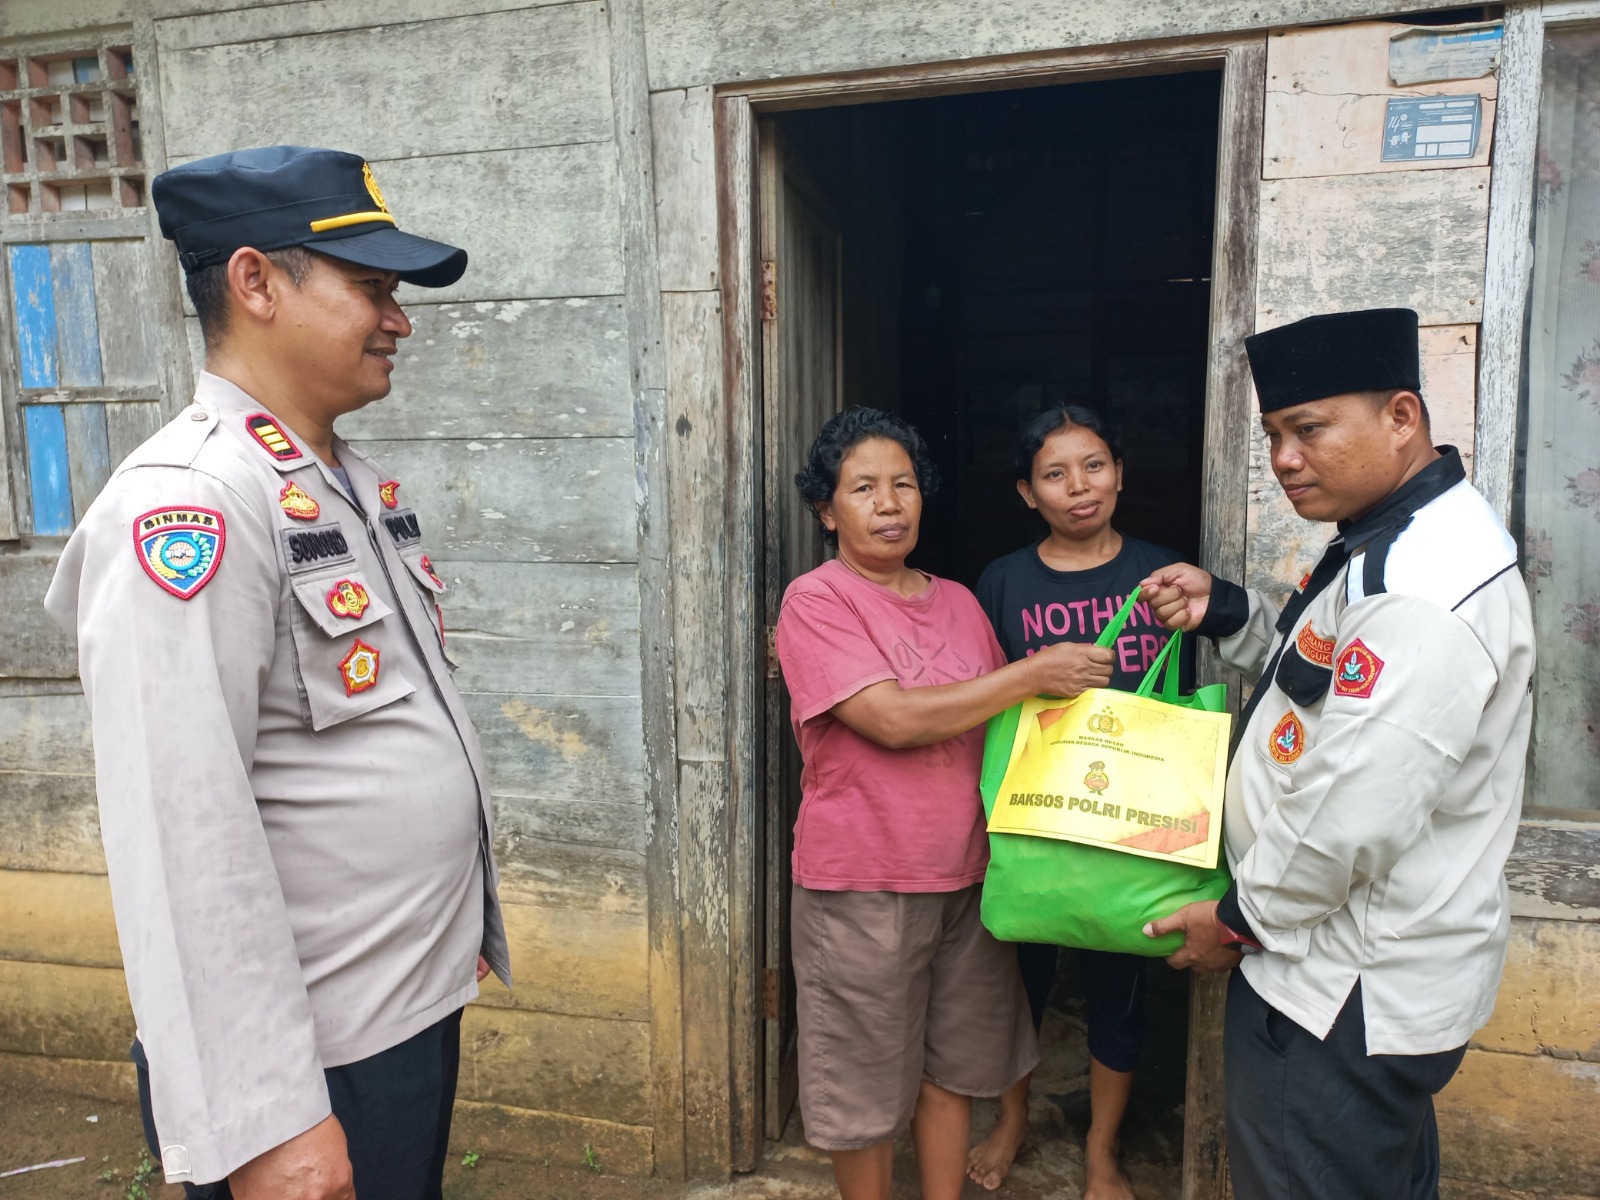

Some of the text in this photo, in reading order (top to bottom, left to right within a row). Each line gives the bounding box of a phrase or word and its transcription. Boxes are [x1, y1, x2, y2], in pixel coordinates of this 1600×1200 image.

[143, 513, 213, 530] BINMAS
[1021, 593, 1165, 642] NOTHIN
[1009, 793, 1198, 834] BAKSOS POLRI PRESISI
